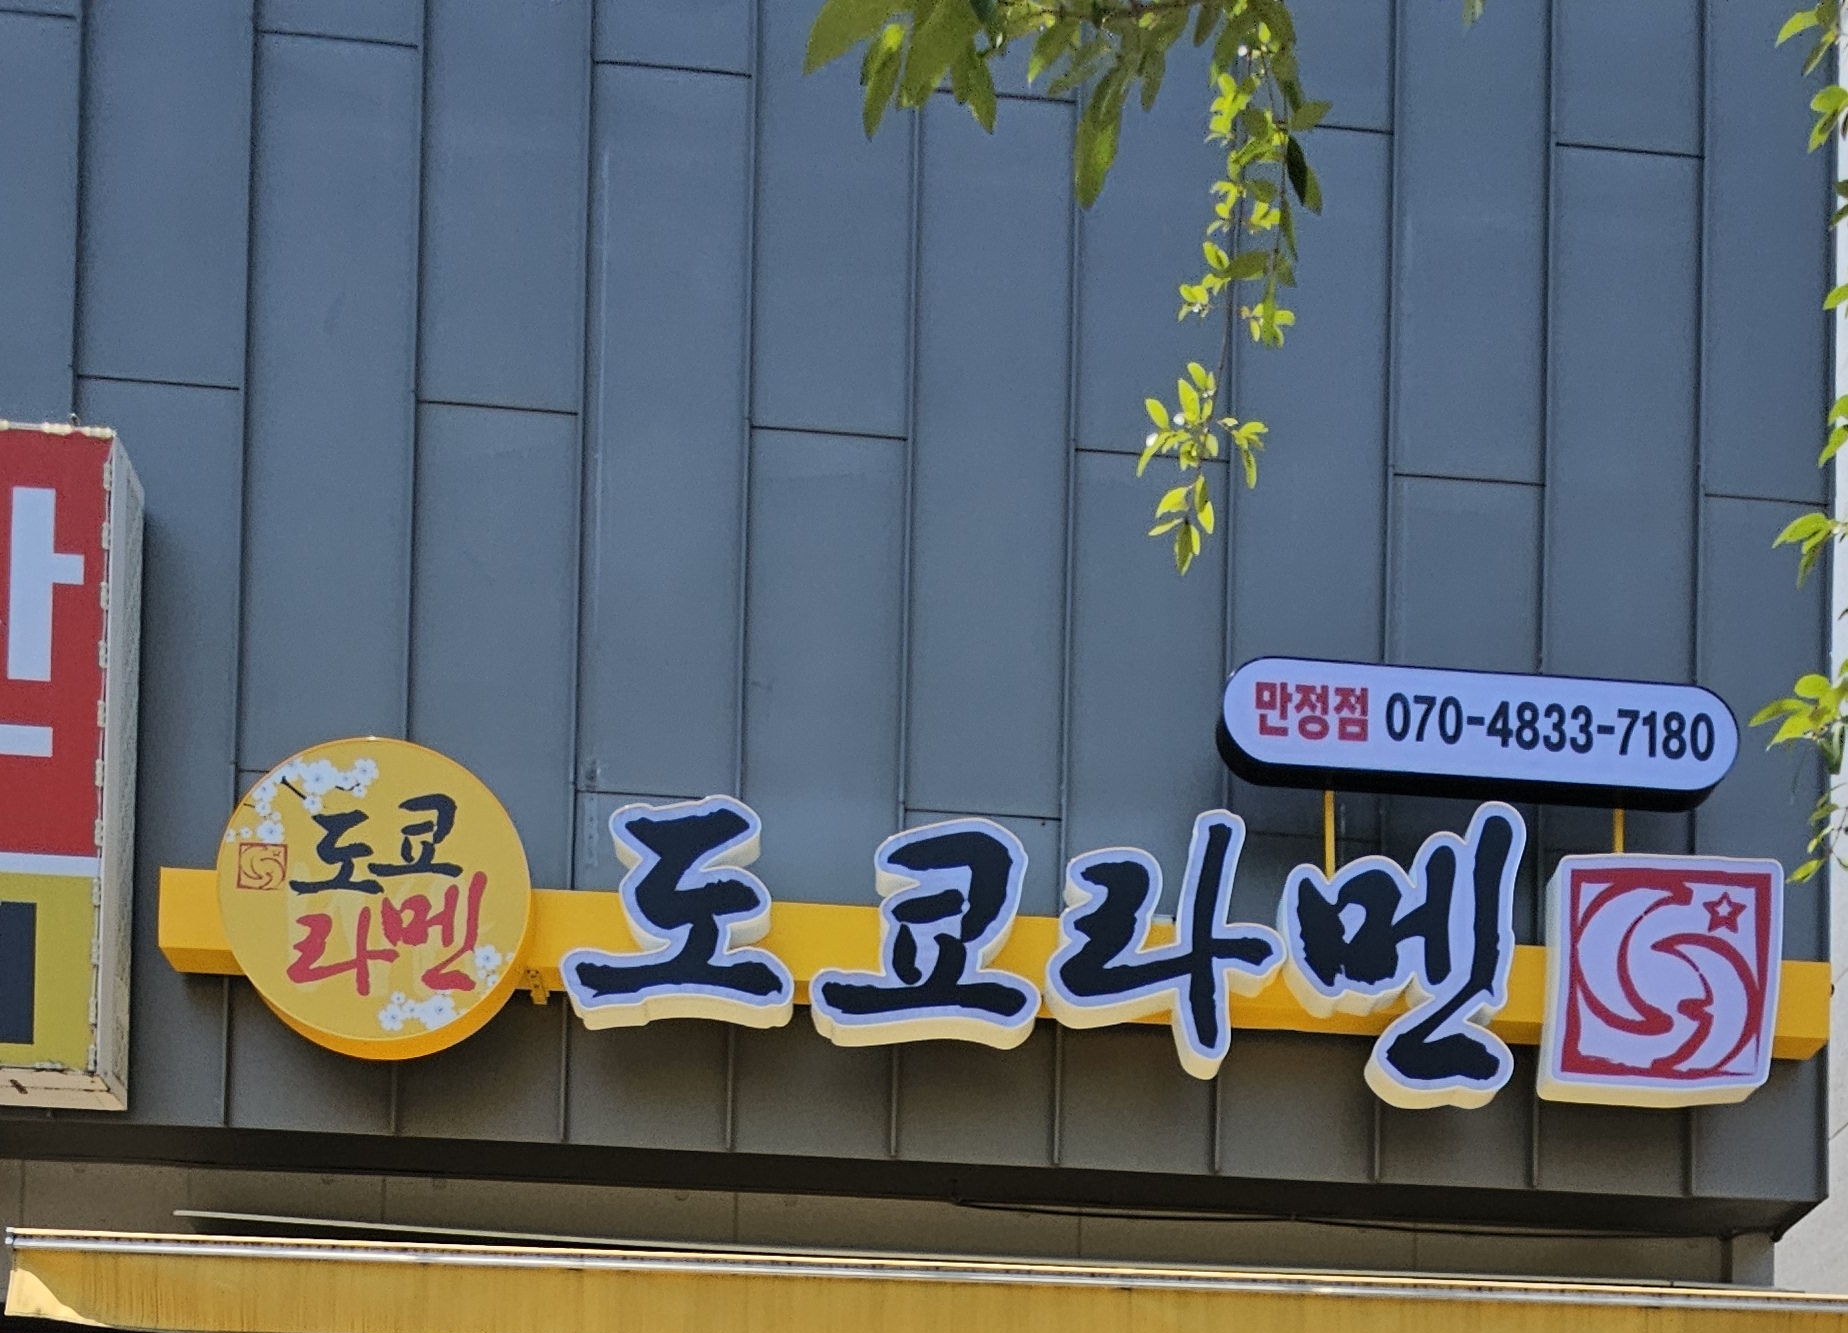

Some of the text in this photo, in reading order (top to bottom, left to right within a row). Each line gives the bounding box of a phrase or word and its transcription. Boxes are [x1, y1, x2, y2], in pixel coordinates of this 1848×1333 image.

[1255, 681, 1715, 762] 만정점 070-4833-7180
[289, 794, 463, 897] 도코
[287, 871, 487, 996] 라멘
[572, 803, 1519, 1081] 도코라멘
